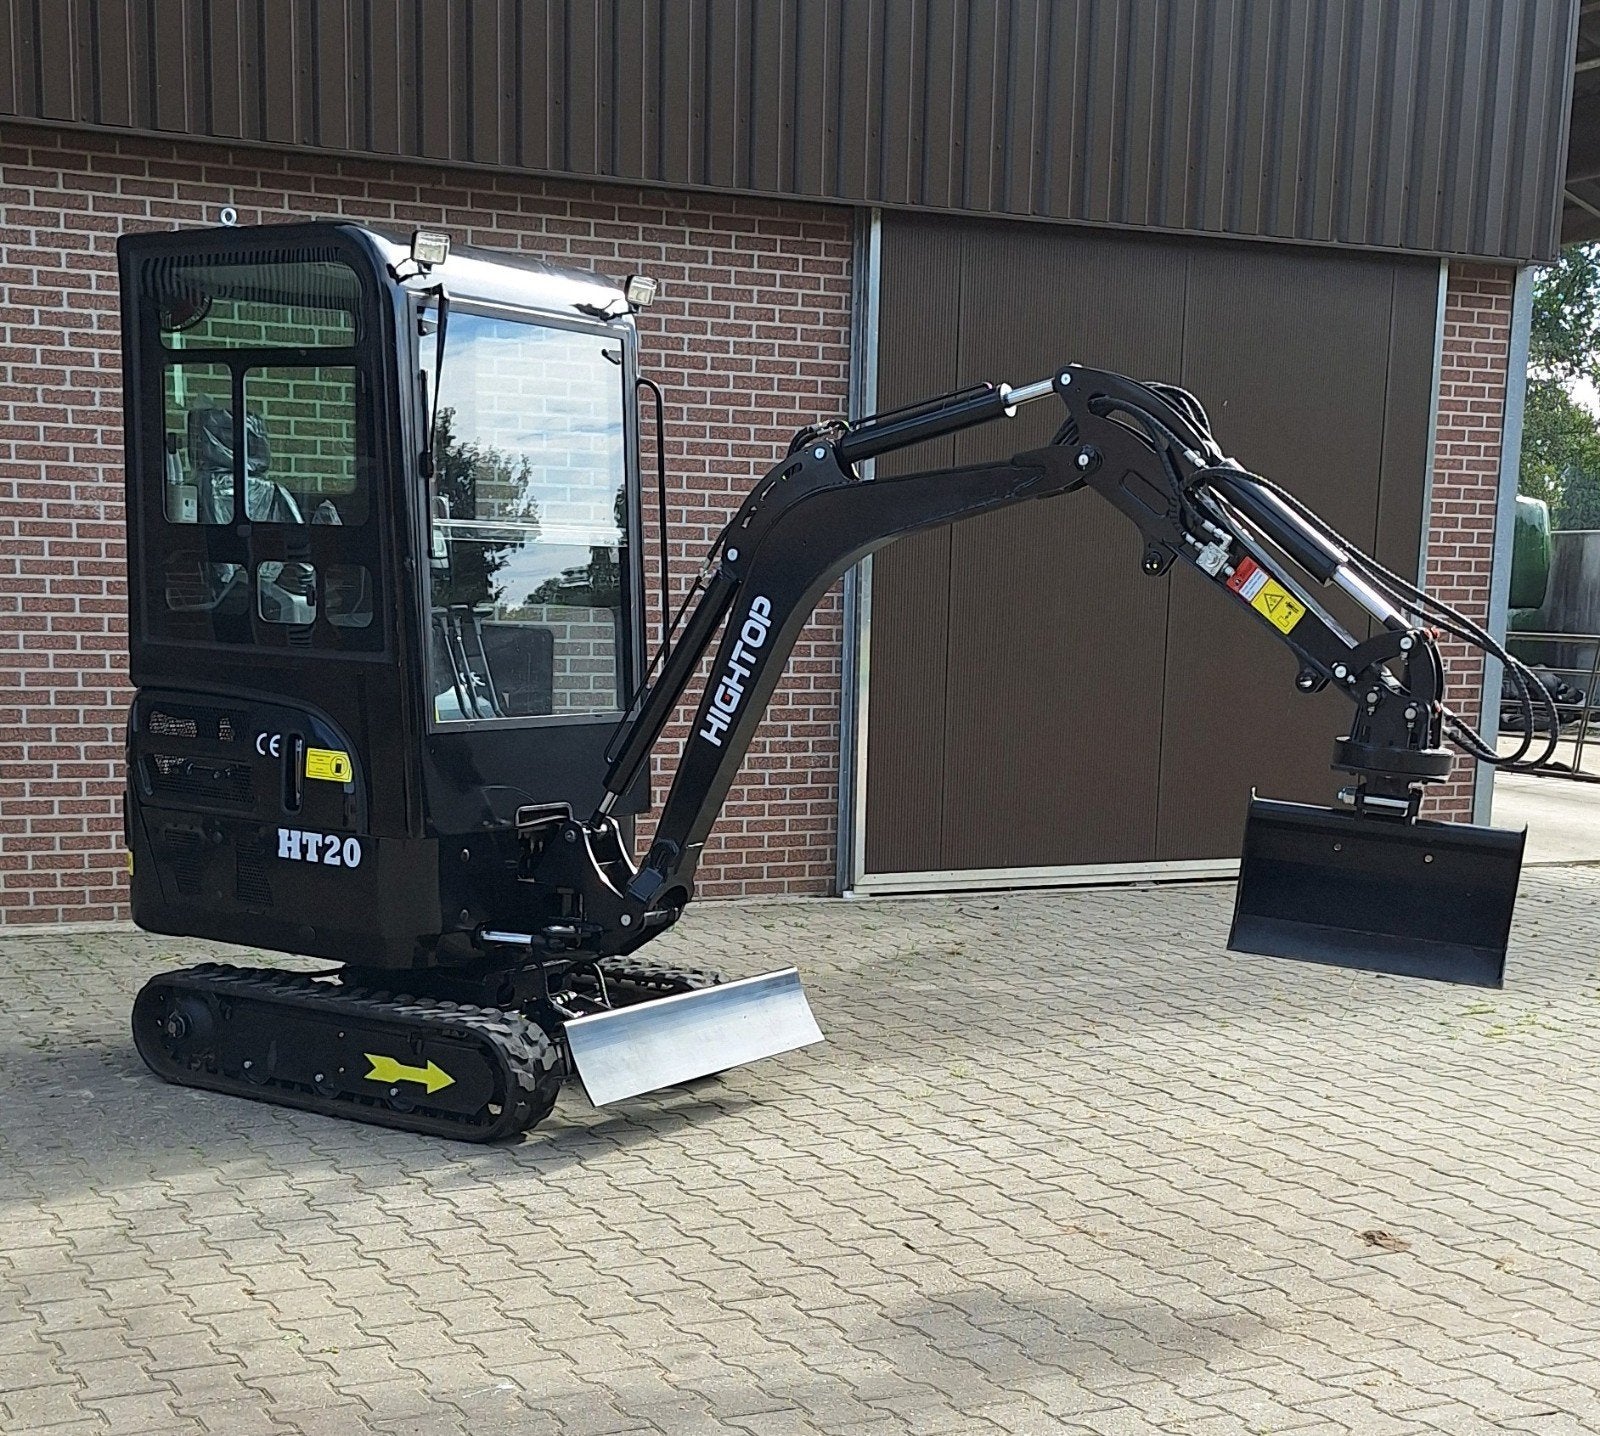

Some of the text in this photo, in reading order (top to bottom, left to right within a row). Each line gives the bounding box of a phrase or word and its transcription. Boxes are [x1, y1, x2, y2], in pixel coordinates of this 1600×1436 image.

[700, 596, 771, 747] HIGHTOP
[256, 732, 281, 758] CE
[277, 828, 362, 868] HT20
